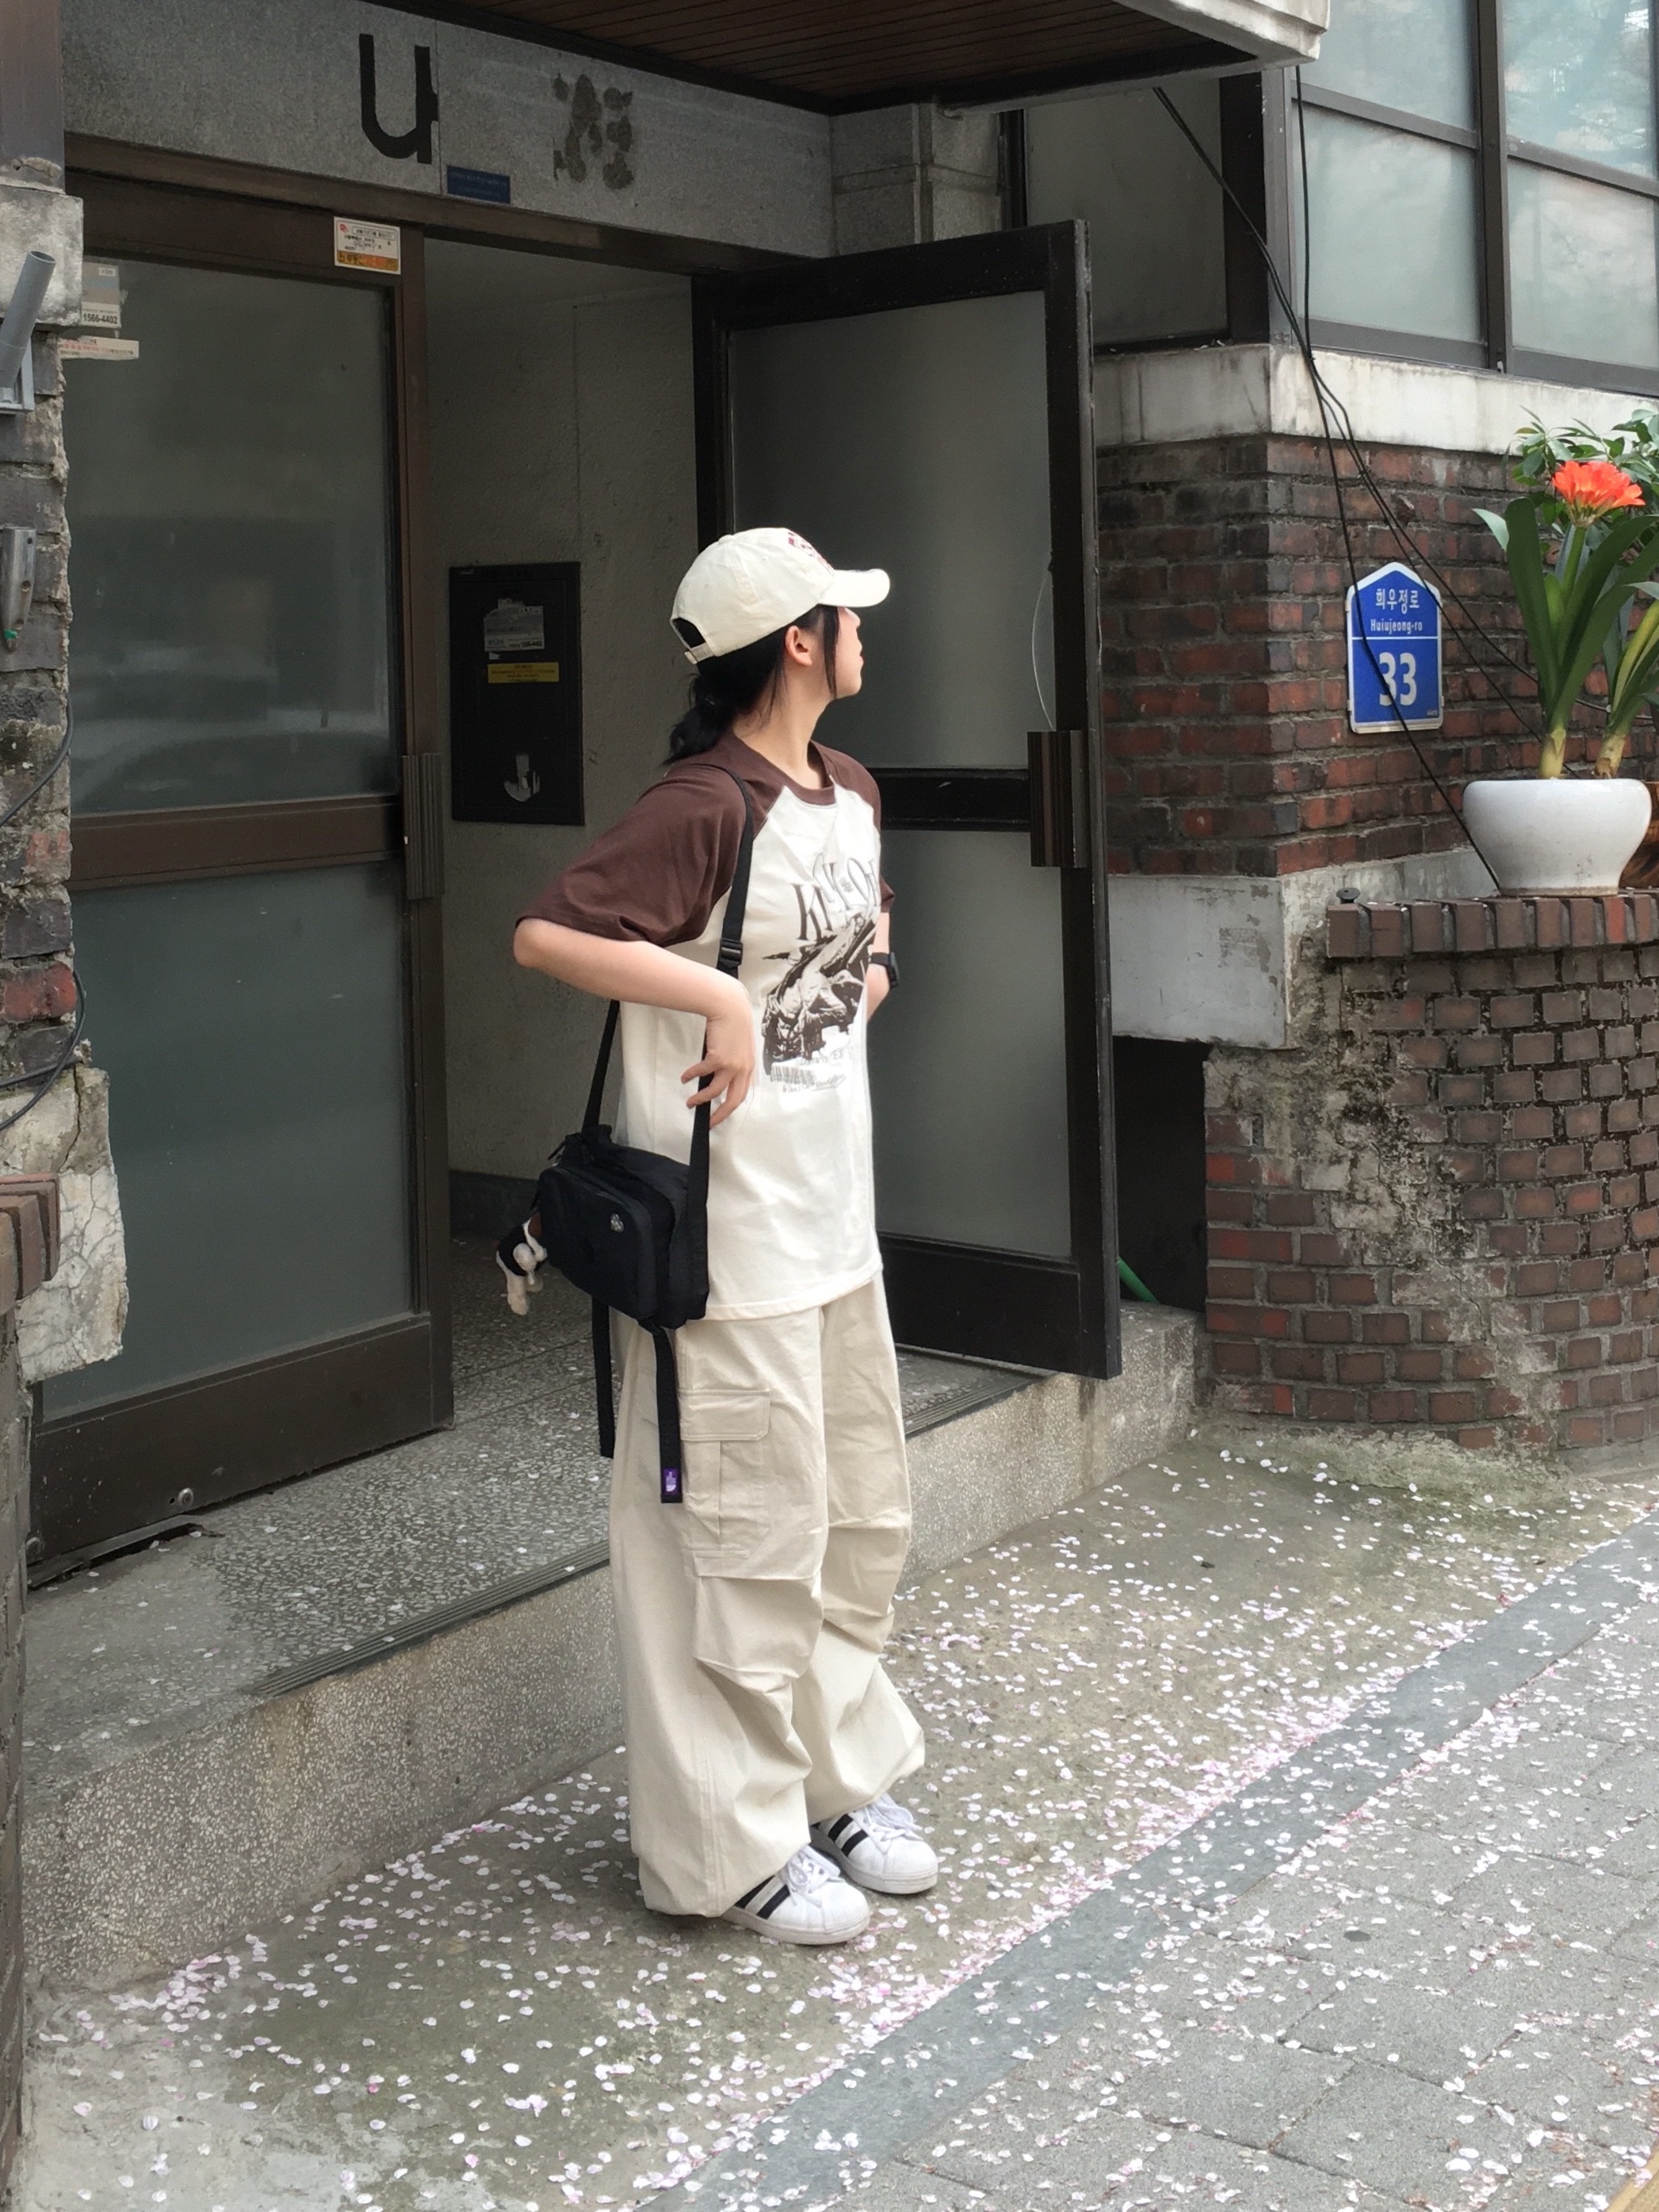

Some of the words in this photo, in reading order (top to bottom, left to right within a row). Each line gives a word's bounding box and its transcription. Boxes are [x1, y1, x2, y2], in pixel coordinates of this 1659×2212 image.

[1375, 588, 1420, 614] 희우정로
[1370, 618, 1423, 634] Huiujeong-ro
[1378, 652, 1417, 706] 33
